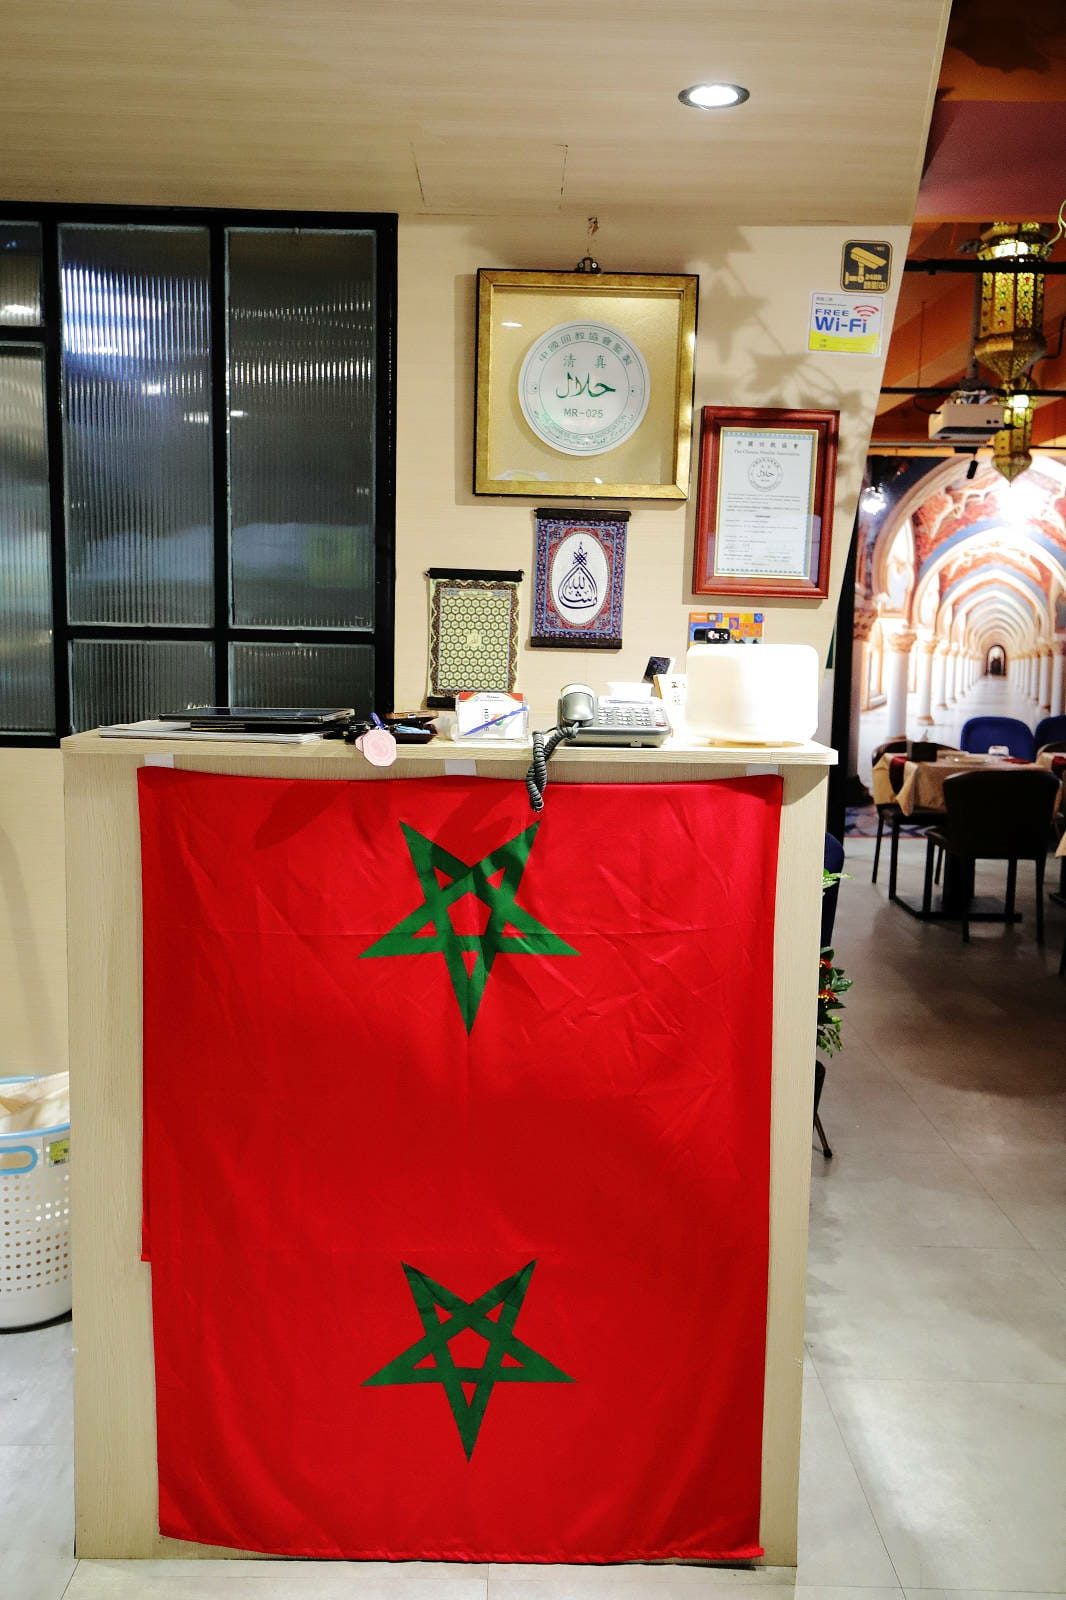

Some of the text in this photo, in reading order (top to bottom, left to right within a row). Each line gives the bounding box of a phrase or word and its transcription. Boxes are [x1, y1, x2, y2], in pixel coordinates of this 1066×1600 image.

[815, 308, 849, 317] FREE
[815, 315, 868, 334] Wi-Fi
[555, 371, 617, 399] حلال
[563, 407, 604, 419] MR-025
